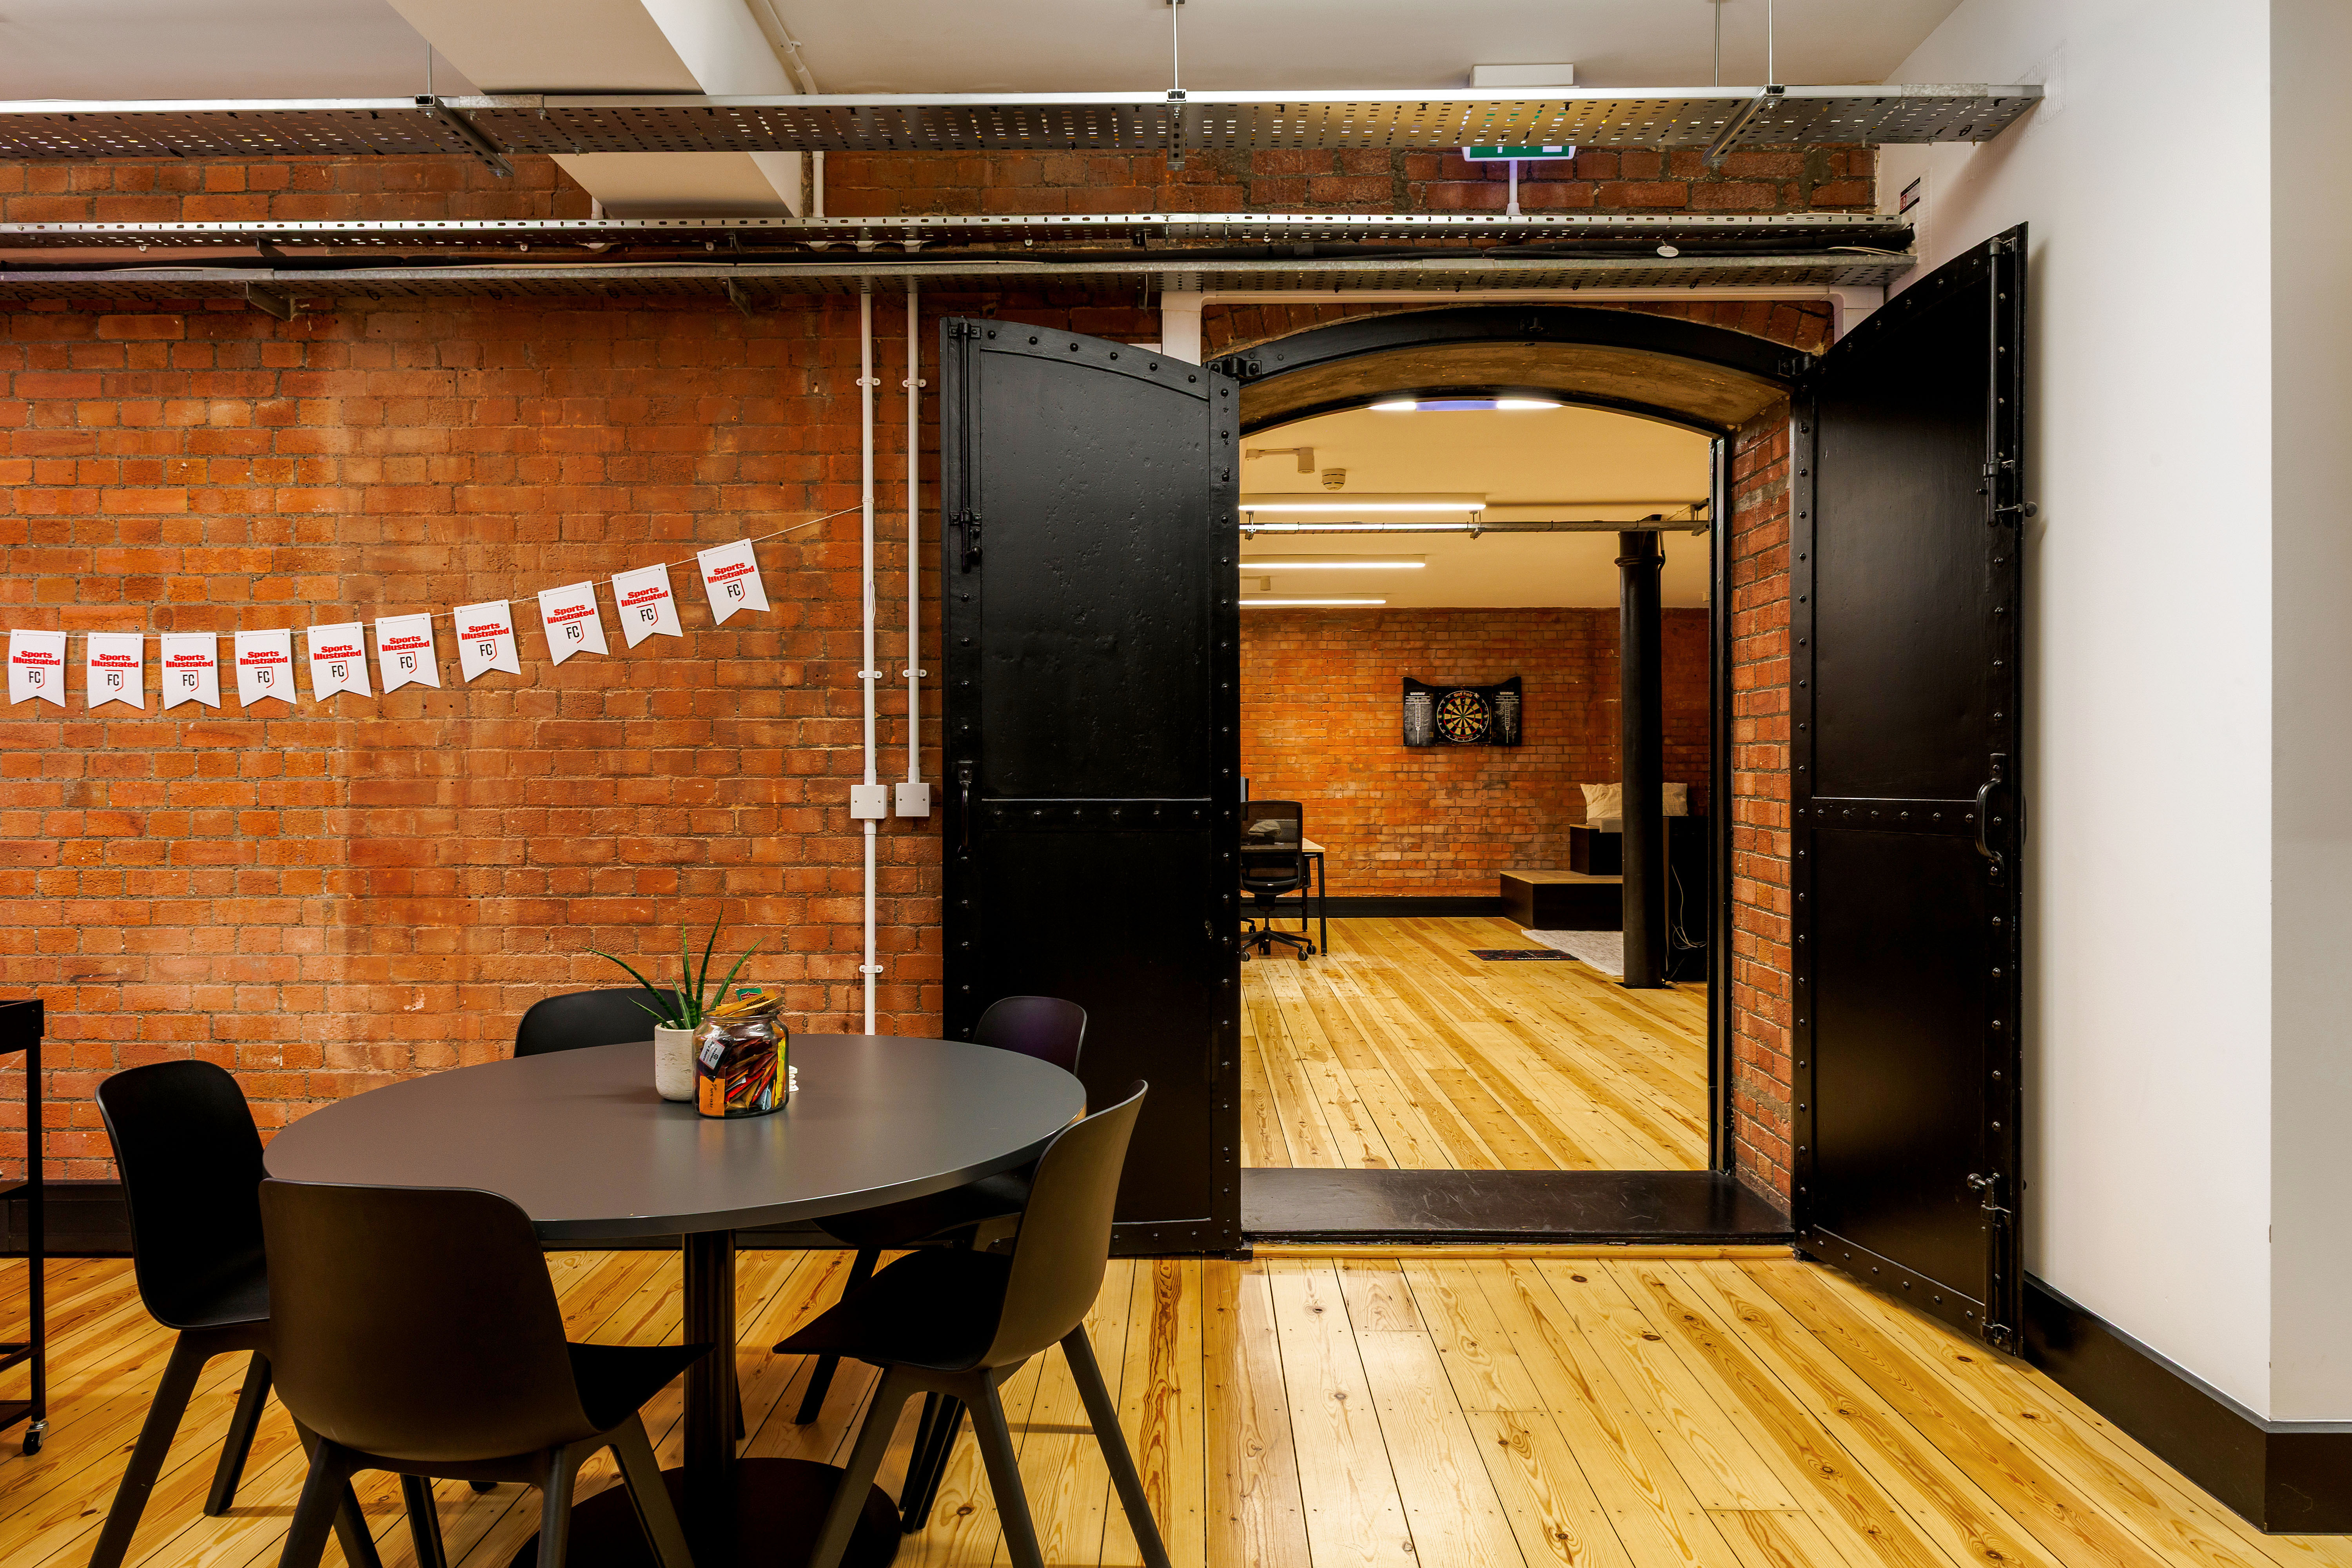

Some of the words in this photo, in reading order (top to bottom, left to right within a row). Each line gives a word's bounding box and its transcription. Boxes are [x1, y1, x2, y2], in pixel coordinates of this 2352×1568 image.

[707, 565, 755, 584] Illustrated
[713, 563, 745, 575] Sports
[627, 587, 659, 599] Sports
[727, 584, 740, 598] FC
[621, 590, 668, 607] Illustrated
[546, 608, 595, 624] Illustrated
[554, 604, 585, 616] Sports
[640, 608, 654, 622] FC
[461, 627, 509, 640] Illustrated
[468, 623, 500, 633] Sports
[566, 626, 580, 639] FC
[381, 640, 430, 652] Illustrated
[389, 636, 421, 644] Sports
[321, 644, 353, 653] Sports
[479, 644, 492, 656] FC
[12, 656, 60, 666] Illustrated
[240, 656, 288, 665] Illustrated
[313, 650, 361, 660] Illustrated
[91, 659, 139, 668] Illustrated
[400, 656, 412, 669] FC
[29, 671, 40, 683] FC
[257, 671, 270, 683] FC
[332, 665, 344, 677] FC
[107, 674, 119, 686] FC
[183, 674, 194, 686] FC
[746, 996, 766, 1007] MEDIUM
[755, 1002, 774, 1012] MEDIUM
